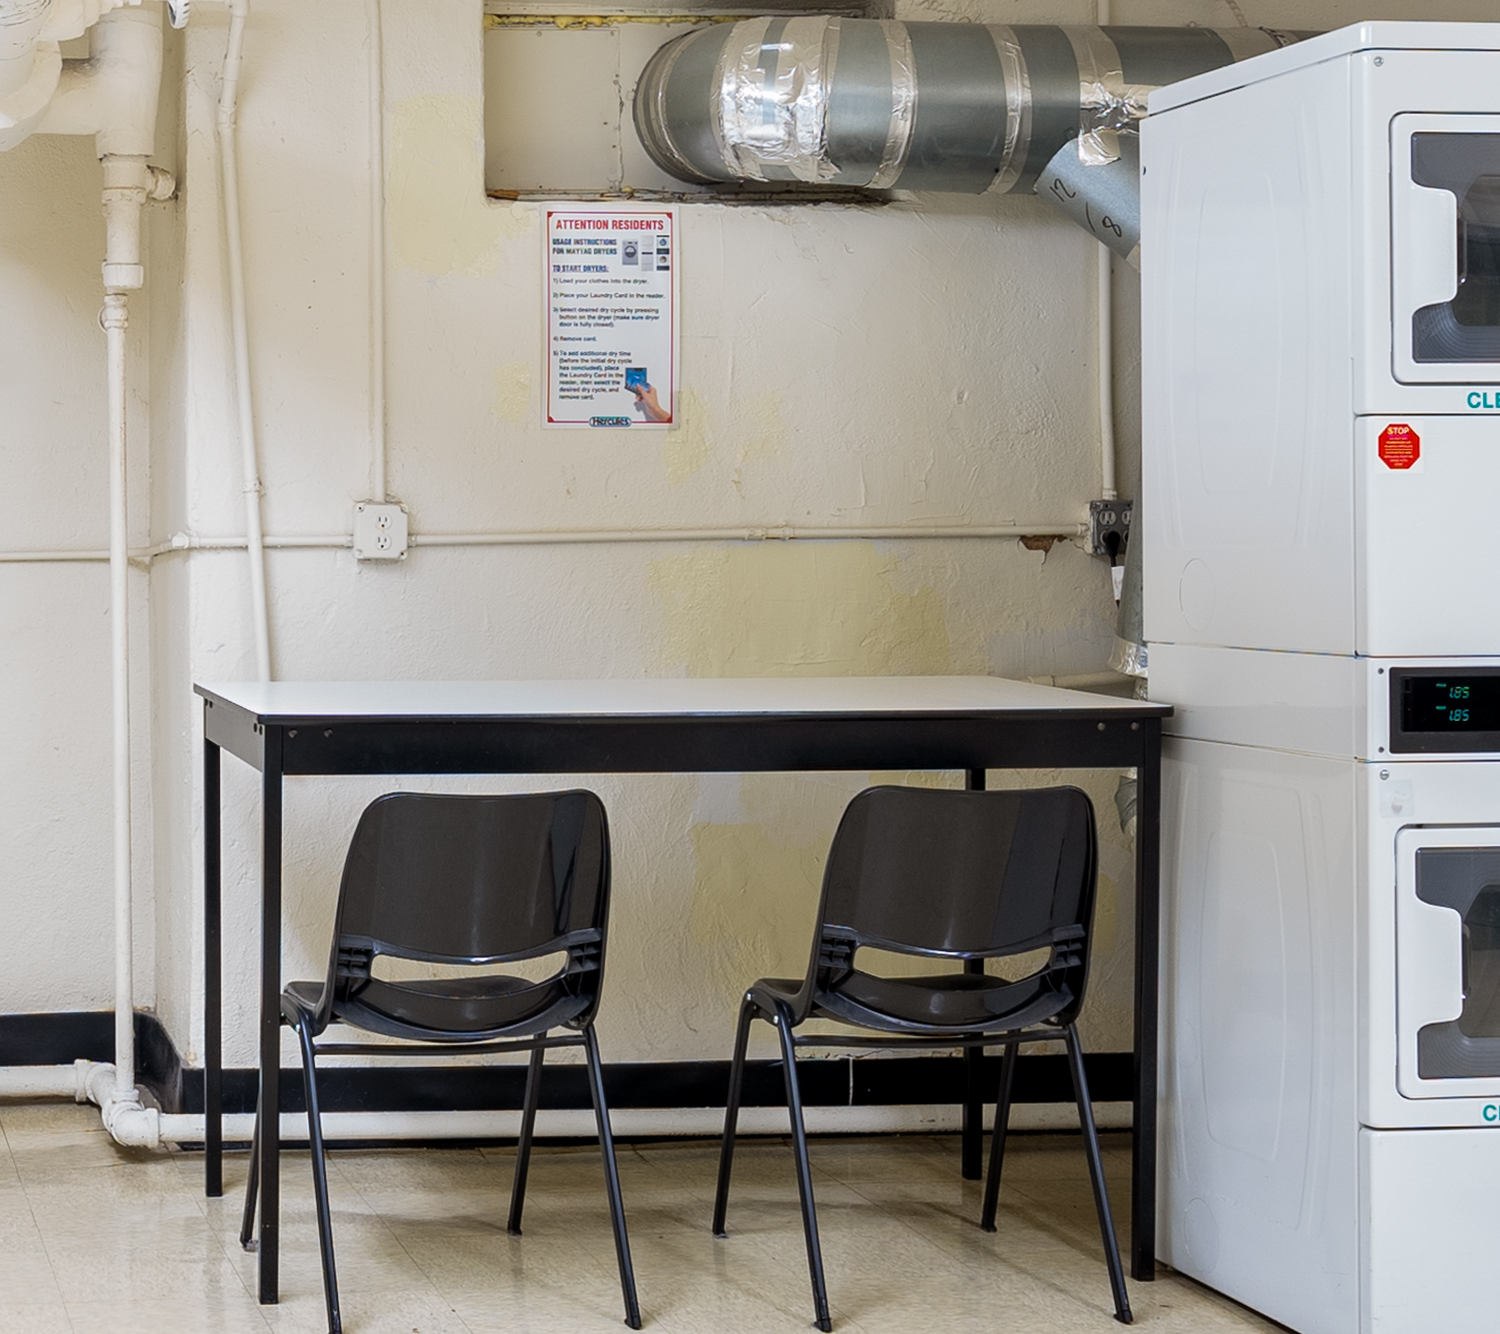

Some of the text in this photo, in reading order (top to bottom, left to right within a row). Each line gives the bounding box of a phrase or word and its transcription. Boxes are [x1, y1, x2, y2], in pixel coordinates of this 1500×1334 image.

[556, 220, 664, 230] ATTENTION RESIDENTS
[1102, 215, 1122, 238] 8
[592, 417, 629, 426] Hercules
[1387, 426, 1410, 435] STOP
